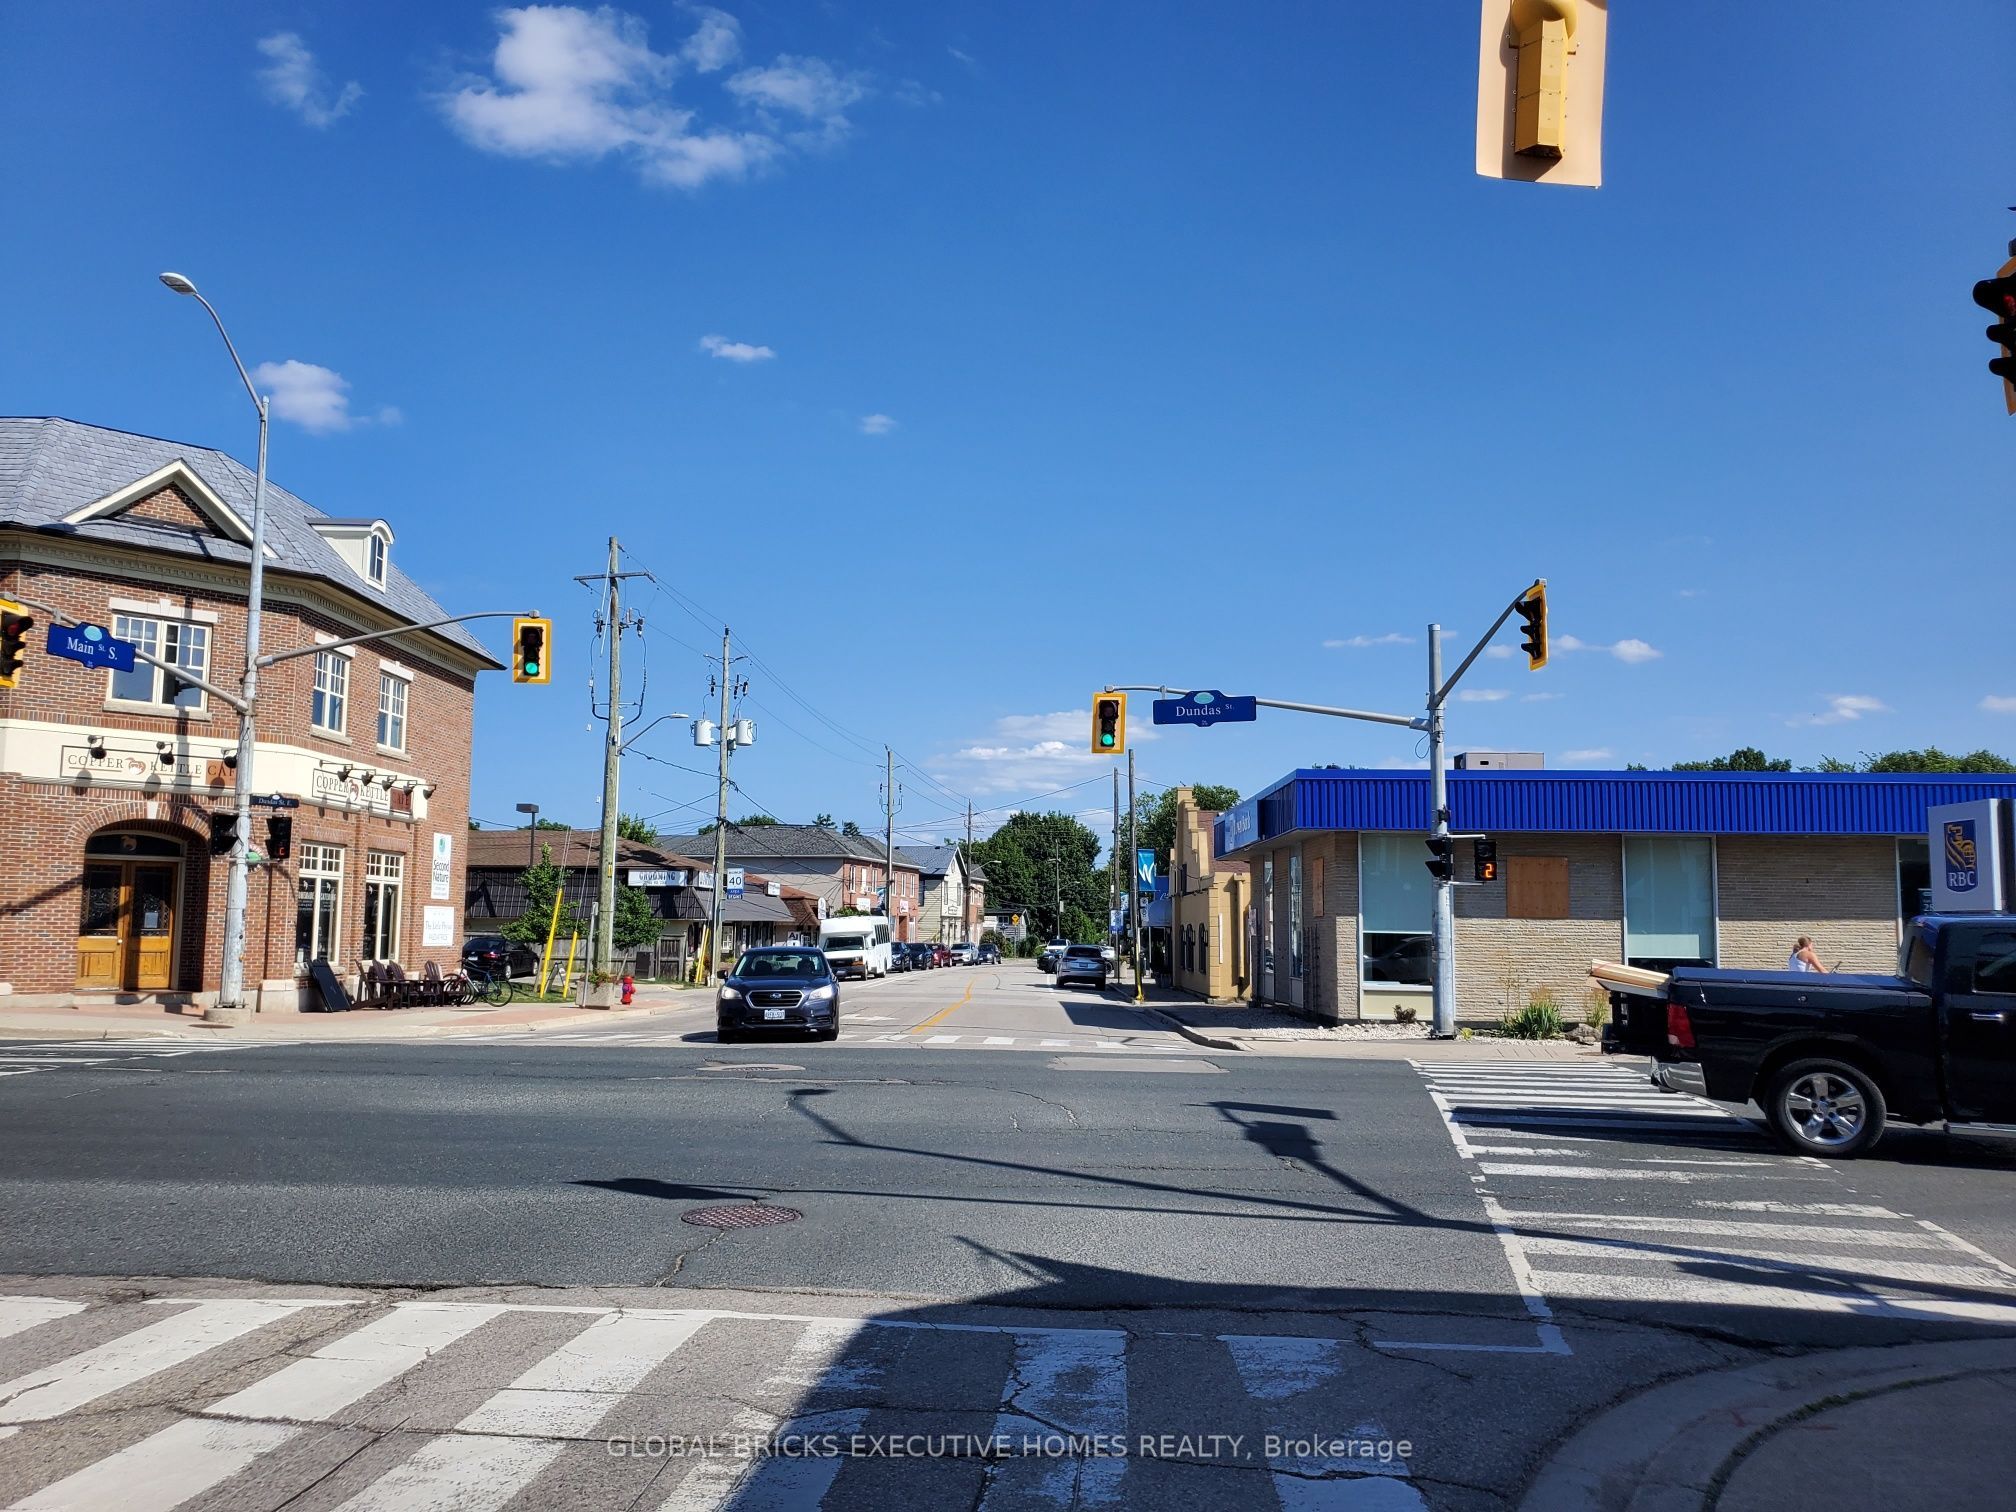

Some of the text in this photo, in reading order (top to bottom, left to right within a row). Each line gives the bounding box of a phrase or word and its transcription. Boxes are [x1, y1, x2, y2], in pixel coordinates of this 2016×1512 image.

[66, 636, 94, 655] Main
[108, 646, 118, 660] S.
[1175, 704, 1221, 717] Dundas
[68, 754, 237, 778] COPPER KETTLE CAF
[316, 775, 349, 794] COPPER
[360, 784, 389, 802] KETTLE
[433, 859, 449, 872] Second
[1485, 863, 1493, 878] 2
[432, 872, 449, 883] Nature
[638, 871, 676, 881] GROOMING
[728, 876, 742, 886] 40
[1947, 870, 1976, 887] RBC
